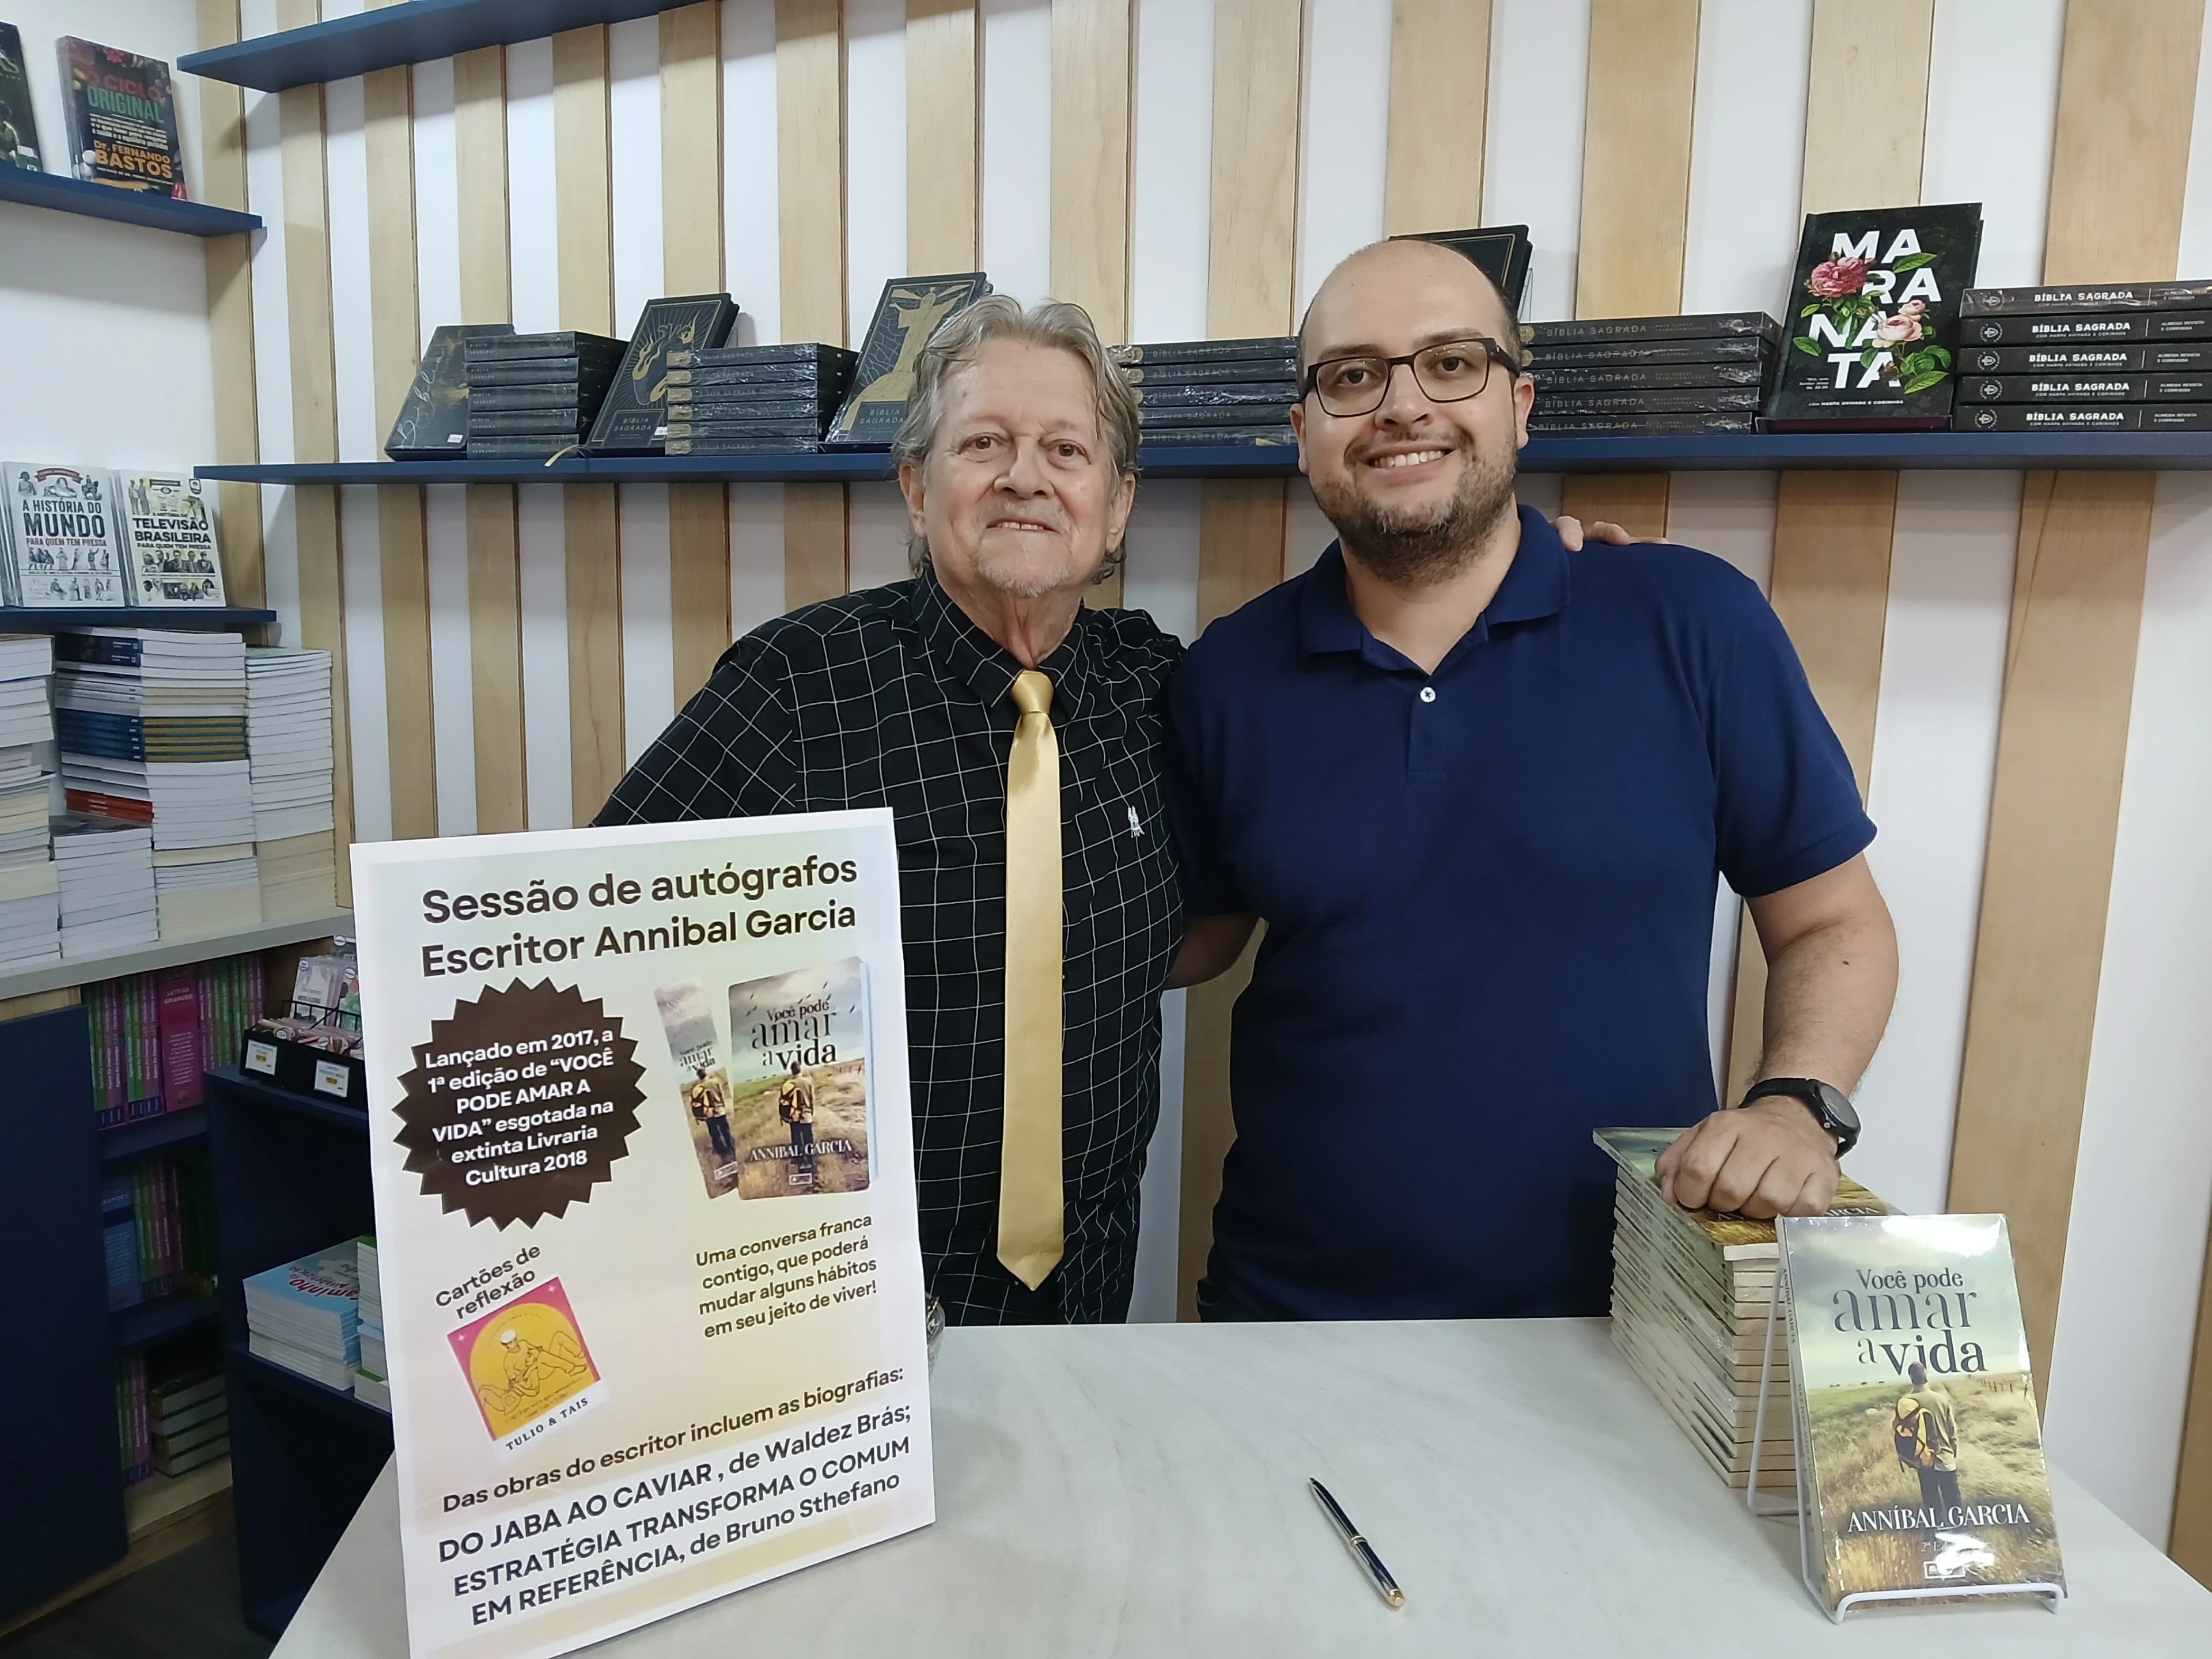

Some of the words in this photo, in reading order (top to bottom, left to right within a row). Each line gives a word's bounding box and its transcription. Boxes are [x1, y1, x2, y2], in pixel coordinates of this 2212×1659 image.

[104, 75, 161, 99] CICLO
[88, 88, 164, 123] ORIGINAL
[94, 140, 109, 150] Dr.
[112, 144, 170, 163] FERNANDO
[96, 149, 172, 179] BASTOS
[1831, 229, 1922, 263] MA
[1862, 268, 1941, 304] RA
[2035, 293, 2072, 302] BÍBLIA
[2078, 291, 2133, 300] SAGRADA
[1547, 328, 1584, 336] BÍBLIA
[1590, 326, 1646, 334] SAGRADA
[2032, 324, 2070, 333] BÍBLIA
[2075, 322, 2131, 331] SAGRADA
[1153, 349, 1181, 357] BÍBLIA
[1546, 351, 1582, 361] BÍBLIA
[1588, 350, 1646, 358] SAGRADA
[2029, 353, 2067, 362] BÍBLIA
[2072, 353, 2127, 361] SAGRADA
[1547, 375, 1584, 384] BÍBLIA
[1590, 374, 1646, 382] SAGRADA
[1827, 352, 1901, 389] TA
[1545, 399, 1582, 408] BÍBLIA
[1588, 397, 1645, 407] SAGRADA
[2032, 382, 2069, 392] BÍBLIA
[2075, 382, 2130, 391] SAGRADA
[2026, 412, 2064, 421] BÍBLIA
[2070, 412, 2124, 421] SAGRADA
[22, 499, 30, 511] A
[33, 498, 83, 513] HISTÓRIA
[88, 501, 101, 513] DO
[24, 513, 105, 538] MUNDO
[132, 517, 209, 531] TELEVISÃO
[135, 531, 211, 543] BRASILEIRA
[423, 880, 578, 923] Sessão
[589, 873, 641, 907] de
[652, 855, 857, 900] autógrafos
[422, 932, 584, 977] Escritor
[594, 912, 736, 956] Annibal
[746, 899, 855, 938] Garcia
[767, 1006, 796, 1022] Você
[799, 999, 830, 1018] pode
[752, 1012, 837, 1050] amar
[425, 1043, 512, 1068] Lançado
[516, 1039, 547, 1055] em
[551, 1030, 599, 1050] 2017,
[602, 1030, 613, 1041] a
[762, 1050, 774, 1067] a
[776, 1039, 837, 1071] vida
[428, 1077, 445, 1093] 1ª
[449, 1067, 518, 1090] edição
[522, 1063, 547, 1078] de
[457, 1091, 512, 1113] PODE
[516, 1081, 573, 1105] AMAR
[577, 1079, 591, 1094] A
[495, 1104, 587, 1131] esgotada
[590, 1101, 613, 1115] na
[452, 1140, 523, 1163] extinta
[527, 1125, 597, 1150] Livraria
[805, 1139, 852, 1154] GARCIA
[465, 1162, 540, 1186] Cultura
[544, 1150, 587, 1172] 2018
[696, 1248, 736, 1266] Uma
[740, 1229, 816, 1256] conversa
[820, 1216, 872, 1237] franca
[435, 1260, 513, 1306] Cartões
[516, 1246, 540, 1265] de
[703, 1263, 774, 1289] contigo,
[777, 1254, 808, 1272] que
[812, 1236, 868, 1266] poderá
[289, 1279, 359, 1300] aminho
[456, 1270, 535, 1319] reflexão
[699, 1290, 756, 1315] mudar
[760, 1276, 815, 1299] alguns
[817, 1259, 876, 1284] hábitos
[1856, 1269, 1906, 1290] Você
[1914, 1268, 1963, 1294] pode
[704, 1321, 732, 1338] em
[736, 1312, 766, 1330] seu
[768, 1302, 806, 1325] jeito
[809, 1294, 830, 1309] de
[833, 1280, 876, 1303] viver!
[1833, 1289, 1977, 1332] amar
[1858, 1338, 1877, 1364] a
[1879, 1330, 1988, 1376] vida
[506, 1425, 544, 1450] TULIO
[548, 1418, 557, 1426] &
[560, 1398, 589, 1418] TAIS
[443, 1490, 488, 1513] Das
[494, 1468, 561, 1497] obras
[566, 1458, 595, 1477] do
[600, 1431, 686, 1467] escritor
[691, 1408, 773, 1442] incluem
[778, 1399, 800, 1416] as
[804, 1368, 904, 1408] biografias:
[439, 1532, 483, 1562] DO
[491, 1509, 562, 1547] JABA
[567, 1495, 607, 1524] AO
[613, 1463, 712, 1509] CAVIAR
[729, 1452, 760, 1474] de
[765, 1423, 852, 1462] Waldez
[858, 1406, 910, 1434] Brás;
[454, 1530, 622, 1596] ESTRATÉGIA
[626, 1474, 795, 1542] TRANSFORMA
[800, 1468, 817, 1487] O
[823, 1437, 910, 1479] COMUM
[1848, 1505, 1945, 1532] ANNÍBAL
[1948, 1503, 2030, 1527] GARCIA
[472, 1596, 512, 1626] EM
[520, 1544, 685, 1611] REFERÊNCIA,
[691, 1533, 721, 1555] de
[727, 1509, 795, 1543] Bruno
[800, 1474, 899, 1518] Sthefano
